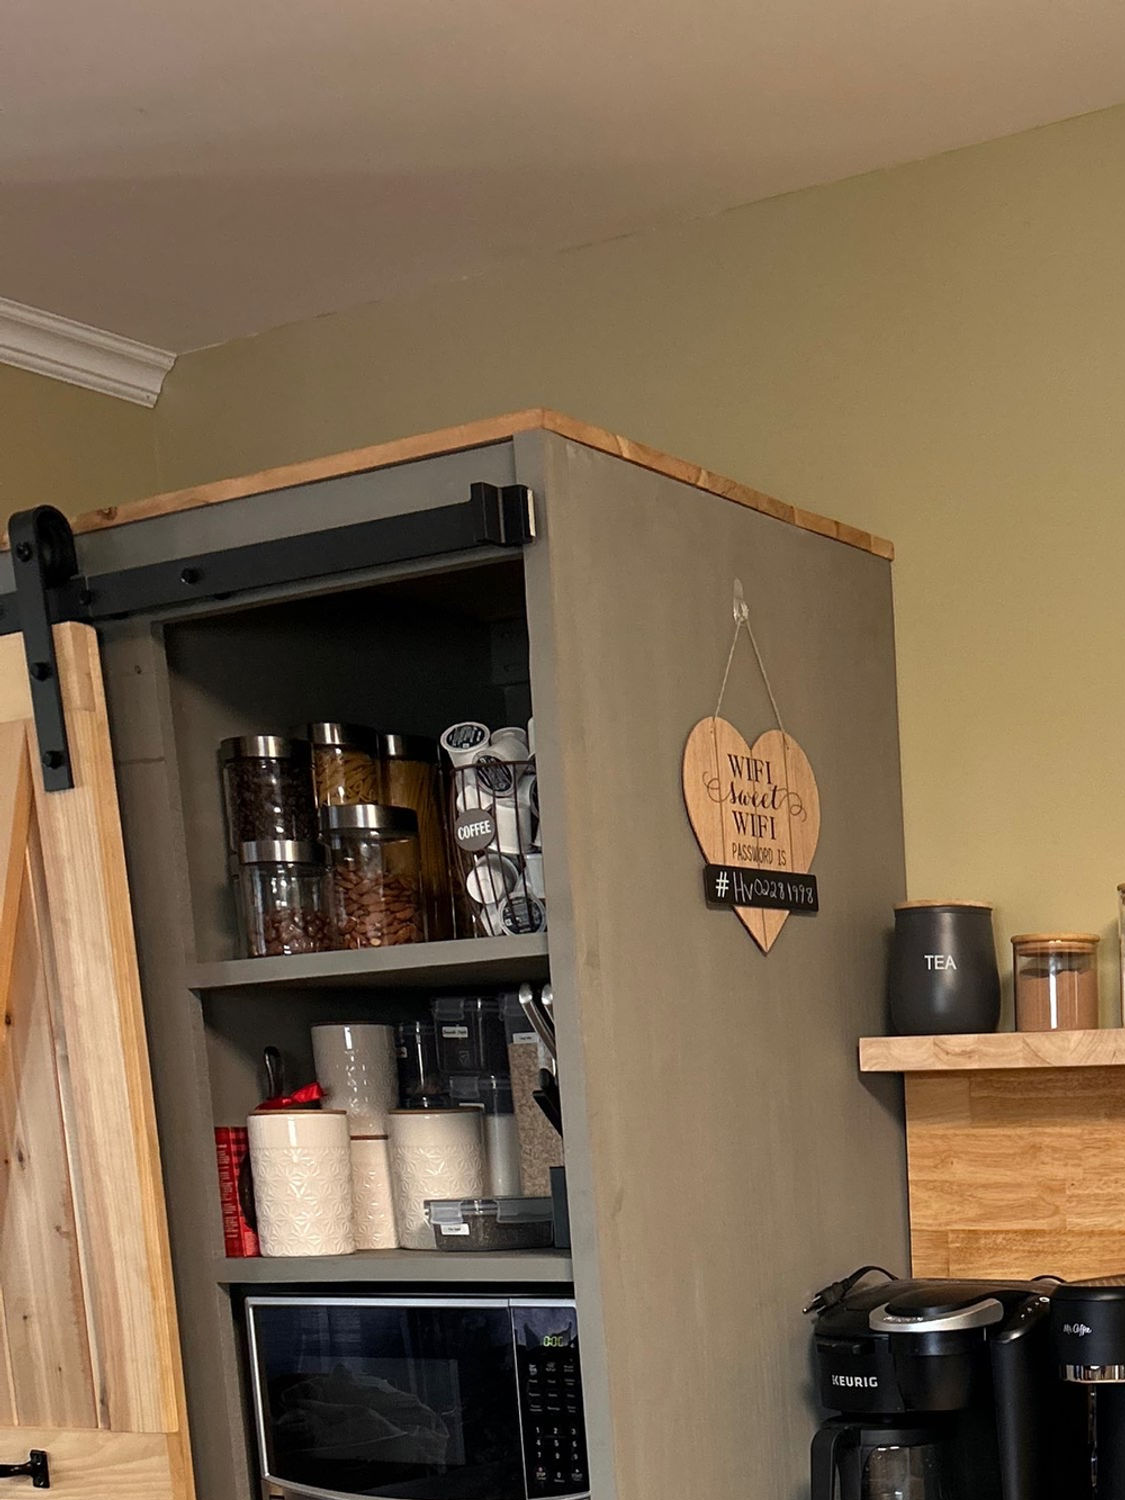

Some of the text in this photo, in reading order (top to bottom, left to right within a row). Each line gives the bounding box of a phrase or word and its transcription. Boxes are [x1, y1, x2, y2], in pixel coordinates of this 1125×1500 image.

[727, 753, 772, 785] WIFI
[457, 819, 492, 841] COFFEE
[731, 809, 777, 840] WIFI
[731, 842, 787, 866] PASSWORD IS
[924, 954, 957, 970] TEA
[831, 1374, 878, 1387] KEURIG
